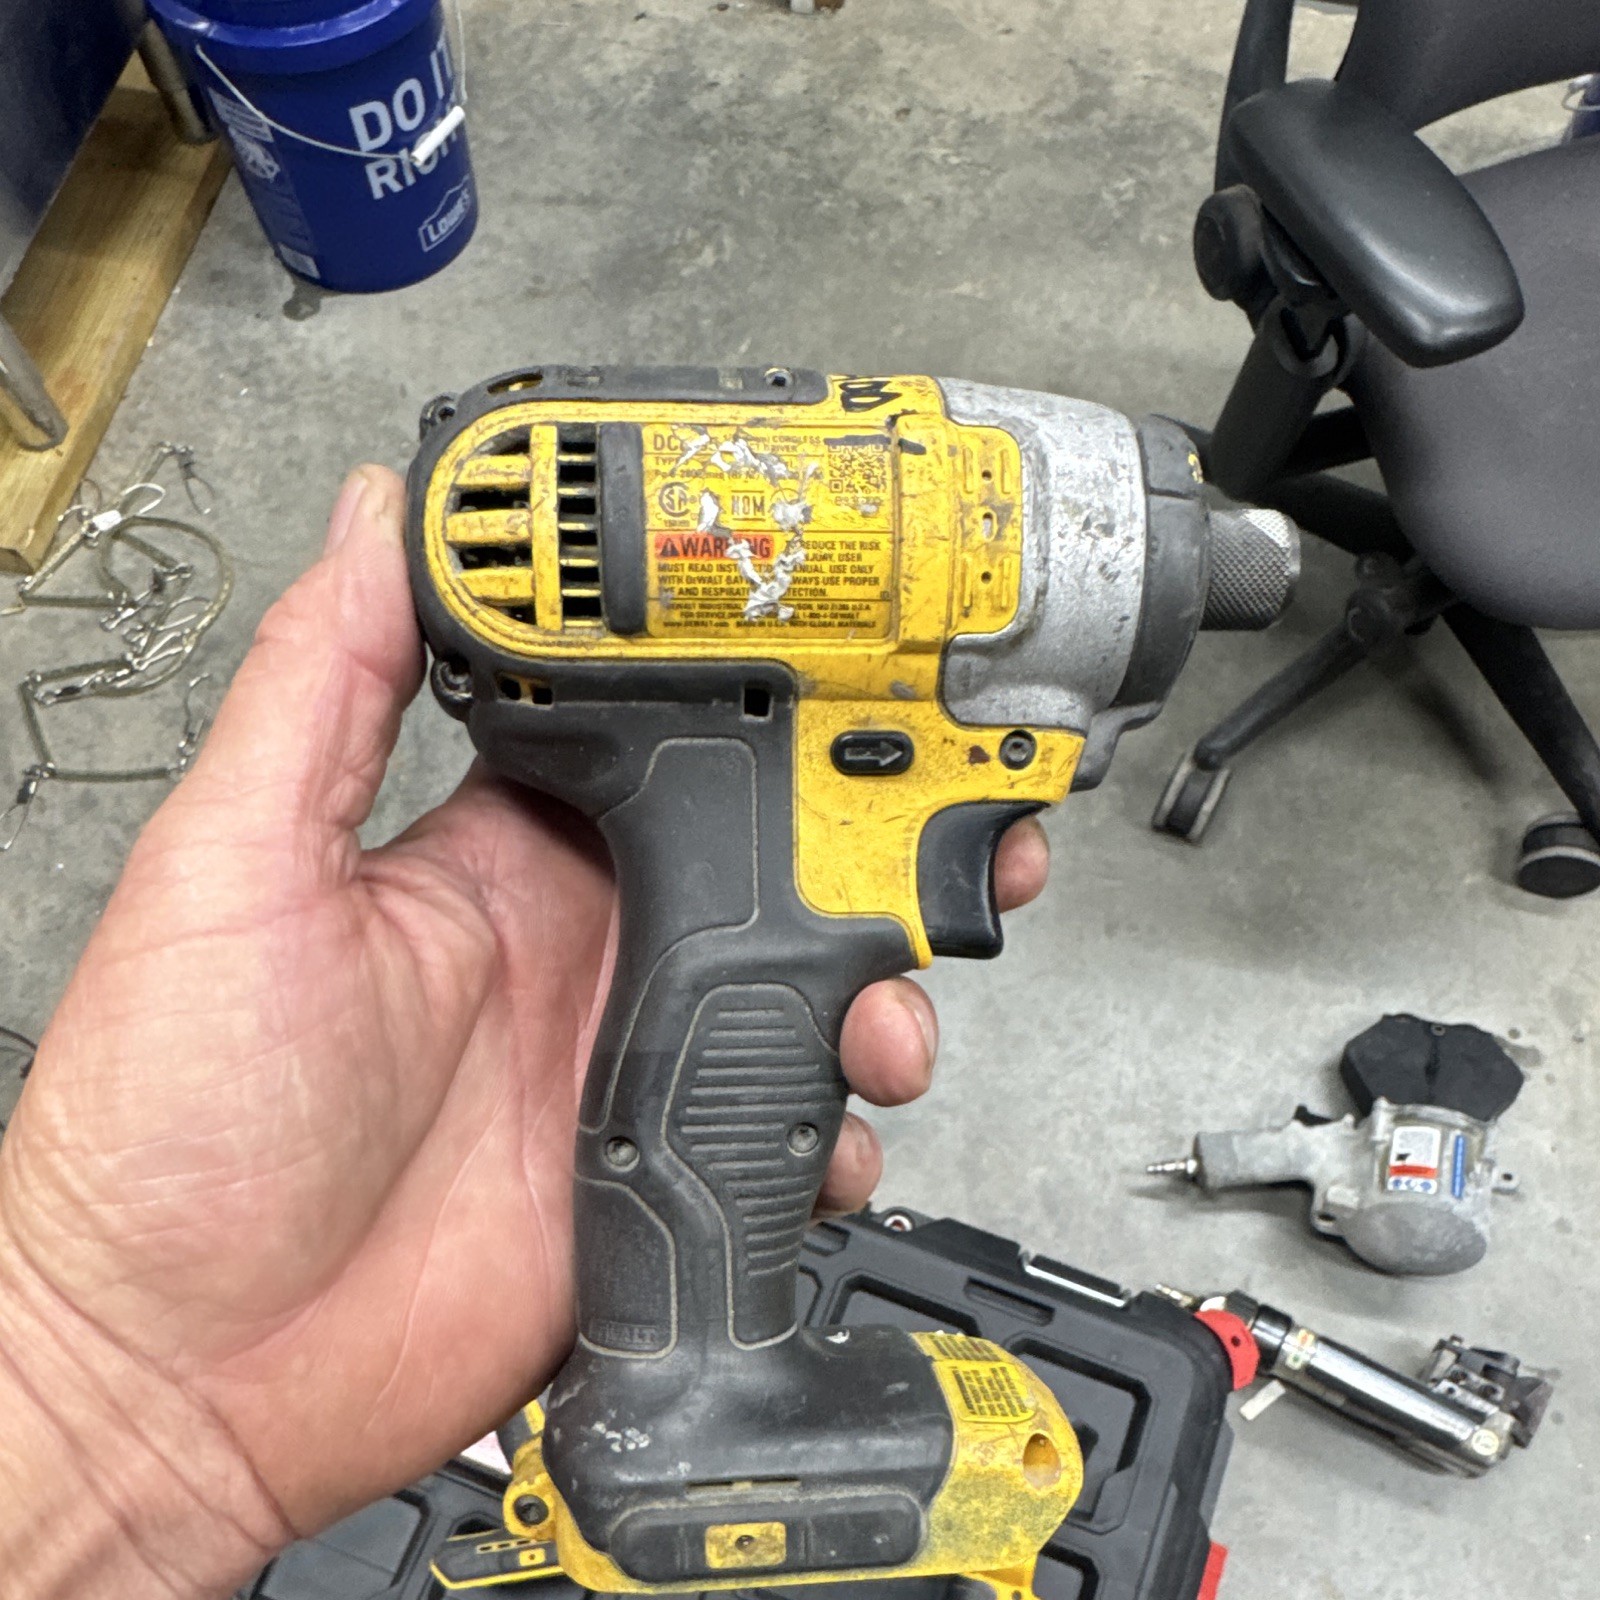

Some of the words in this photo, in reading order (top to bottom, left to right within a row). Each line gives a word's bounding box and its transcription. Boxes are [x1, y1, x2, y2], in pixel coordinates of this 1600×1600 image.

[349, 78, 426, 153] DO
[682, 536, 772, 558] WARNG
[839, 541, 858, 551] THE
[658, 563, 685, 573] MUST
[688, 563, 714, 573] READ
[829, 565, 848, 574] USE
[850, 565, 875, 575] ONLY
[658, 574, 684, 584] WITH
[822, 577, 841, 586] USE
[843, 577, 880, 586] PROPER
[678, 587, 700, 597] AND
